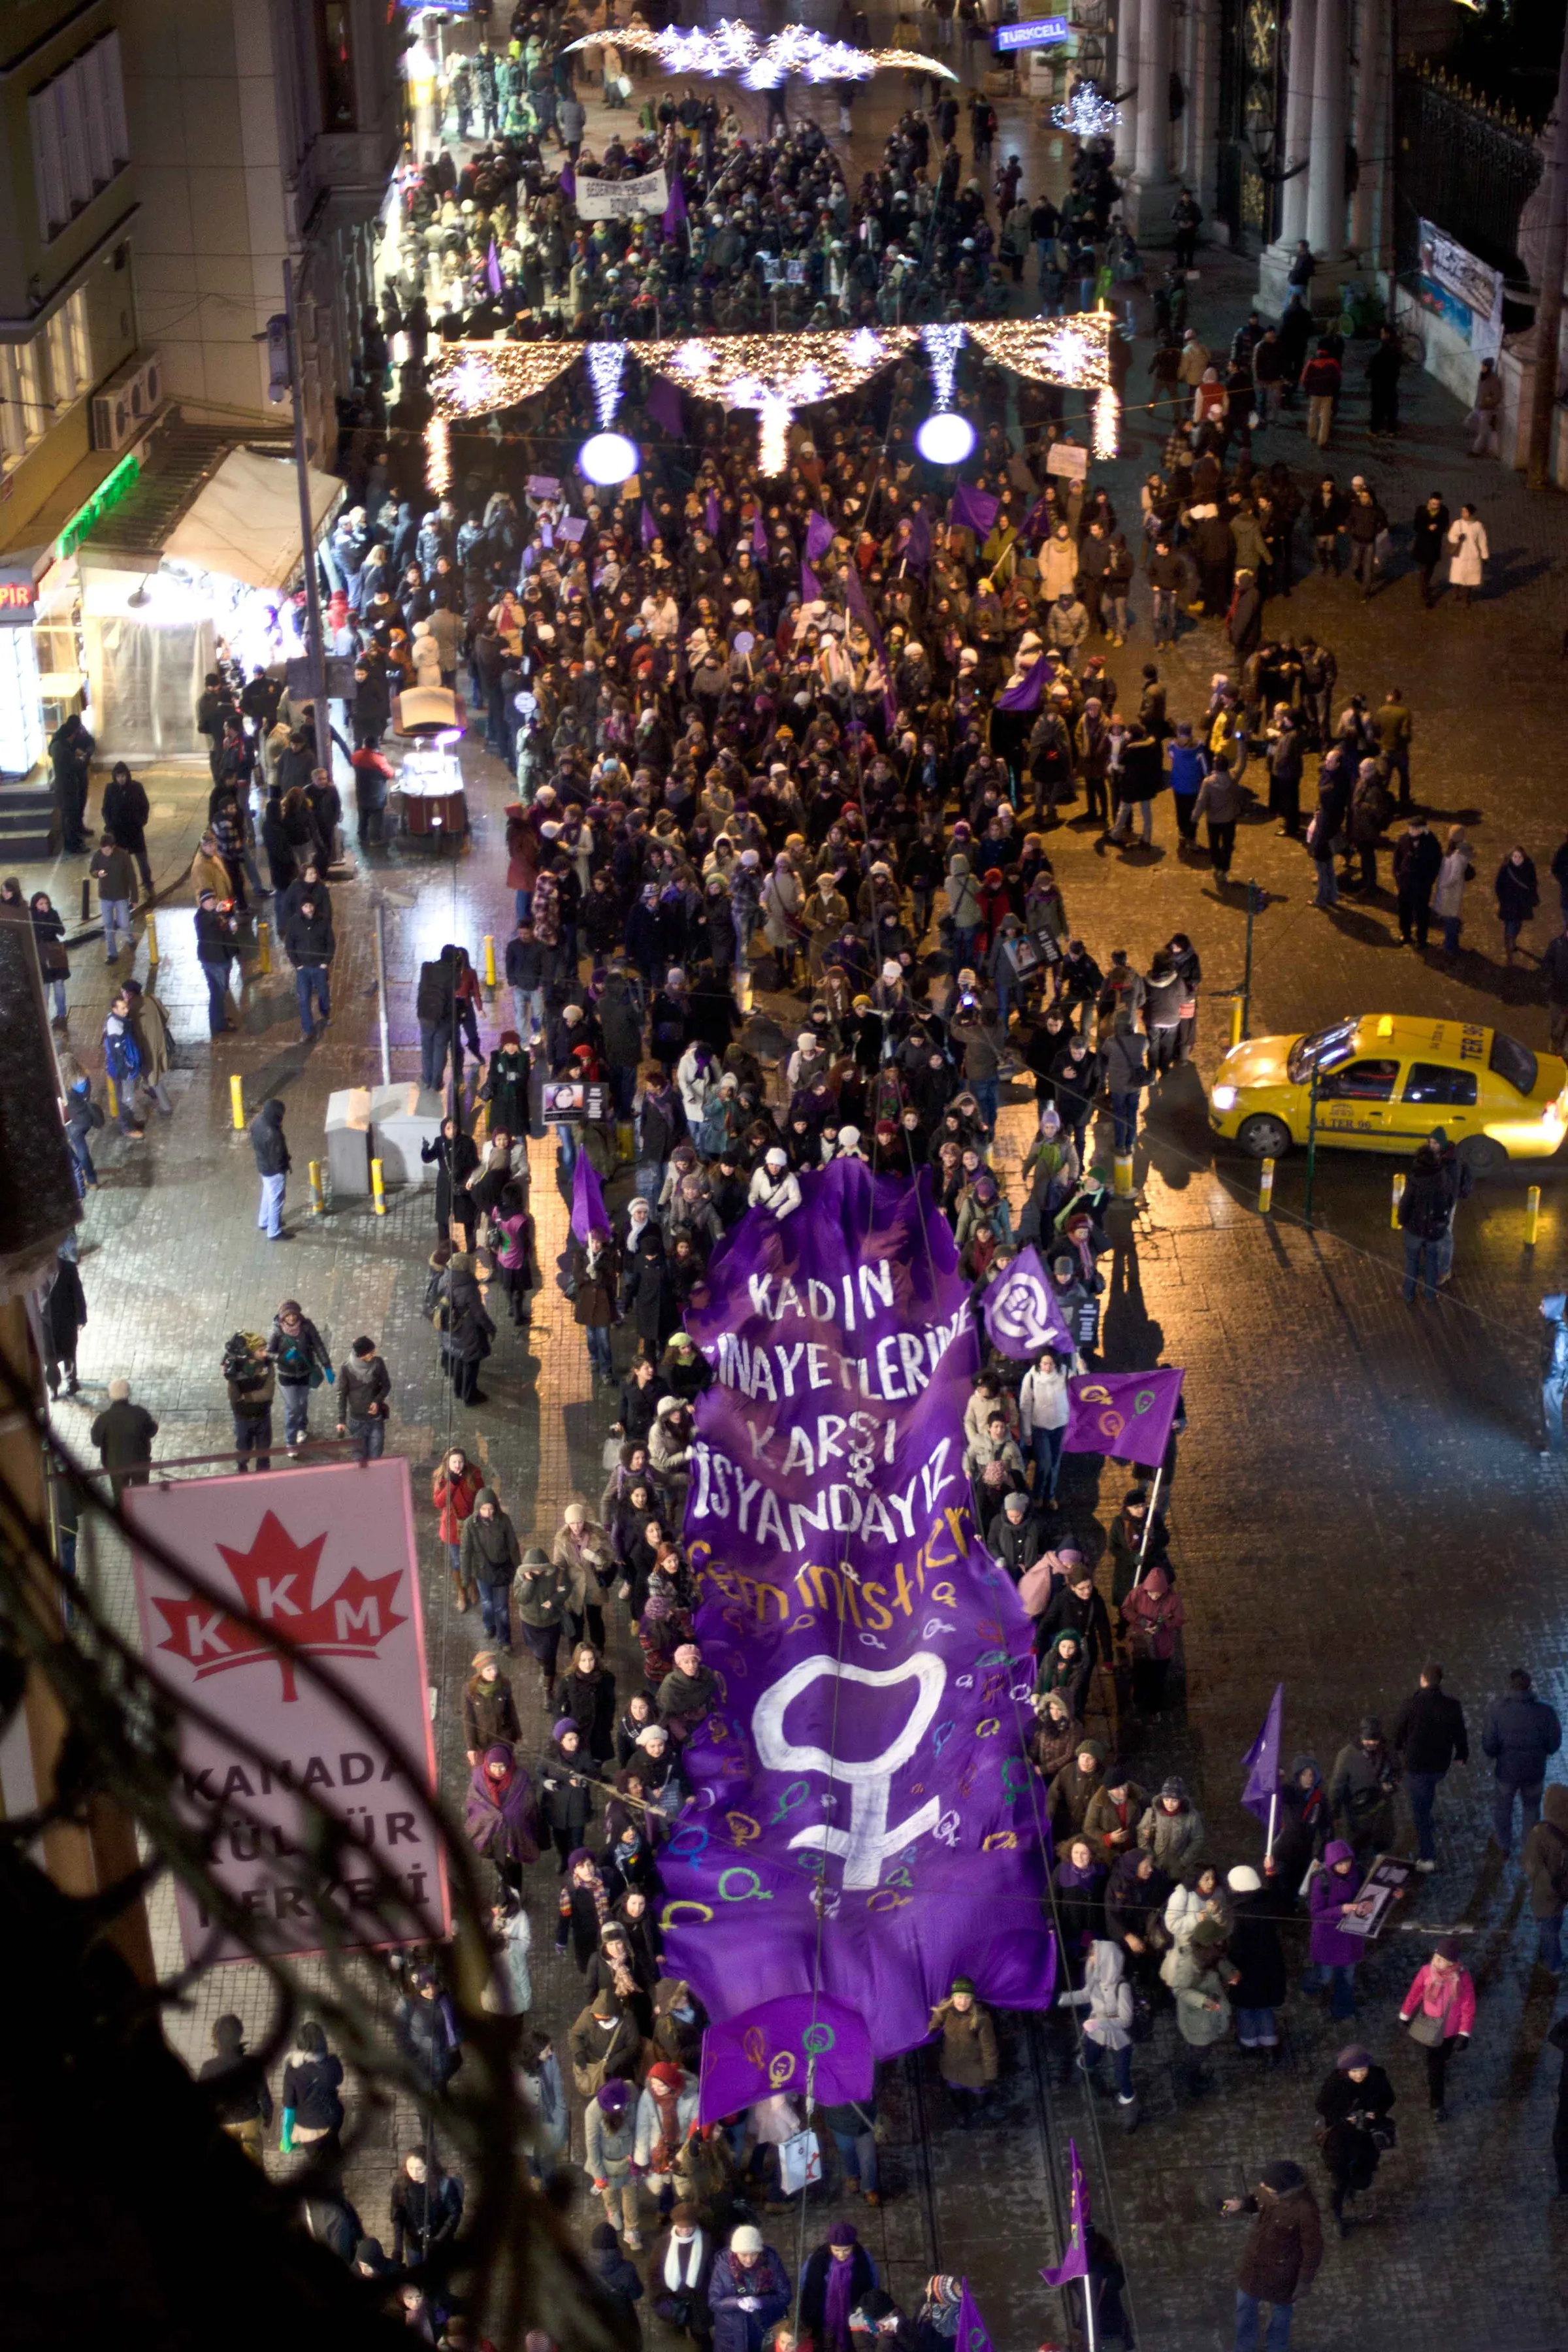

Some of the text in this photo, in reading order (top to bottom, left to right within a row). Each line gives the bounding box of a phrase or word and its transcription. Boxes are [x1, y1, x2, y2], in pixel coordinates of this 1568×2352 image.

[1000, 23, 1065, 43] TURKCELL
[1460, 1038, 1483, 1060] TER
[1331, 1118, 1354, 1129] TER
[748, 1258, 894, 1331] KADIN
[693, 1437, 956, 1552] İSYANDAYIZ
